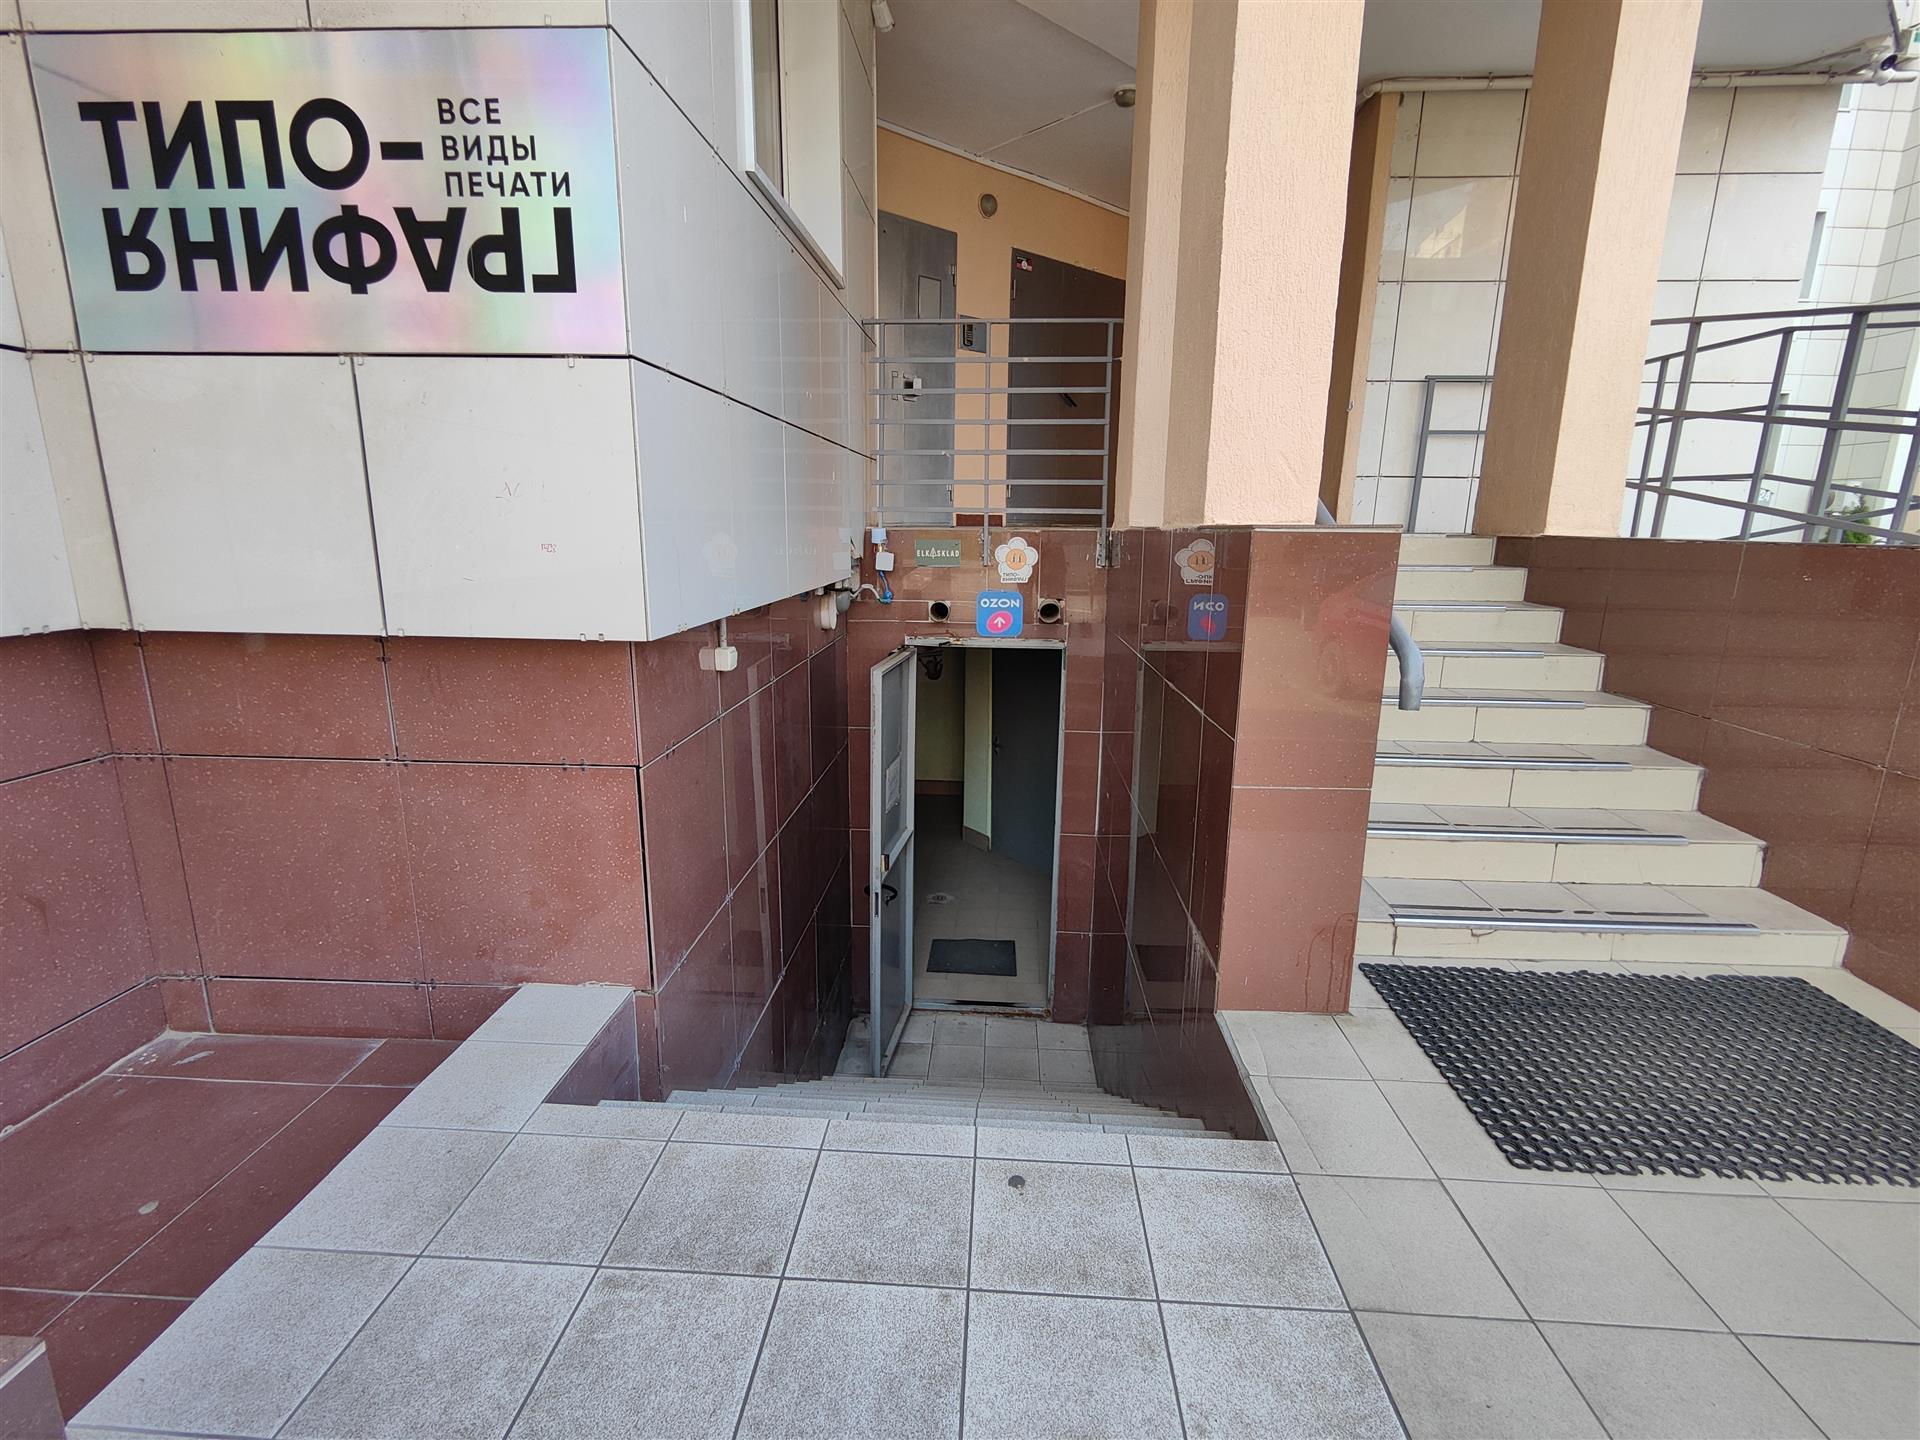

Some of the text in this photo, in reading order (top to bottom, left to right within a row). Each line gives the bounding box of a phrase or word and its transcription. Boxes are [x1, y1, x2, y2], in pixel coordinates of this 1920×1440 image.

[436, 98, 501, 125] ВСЕ
[78, 98, 424, 190] ТИПО-
[441, 135, 536, 165] ВИДЫ
[444, 171, 571, 197] ПЕЧАТИ
[980, 598, 1020, 608] OZON
